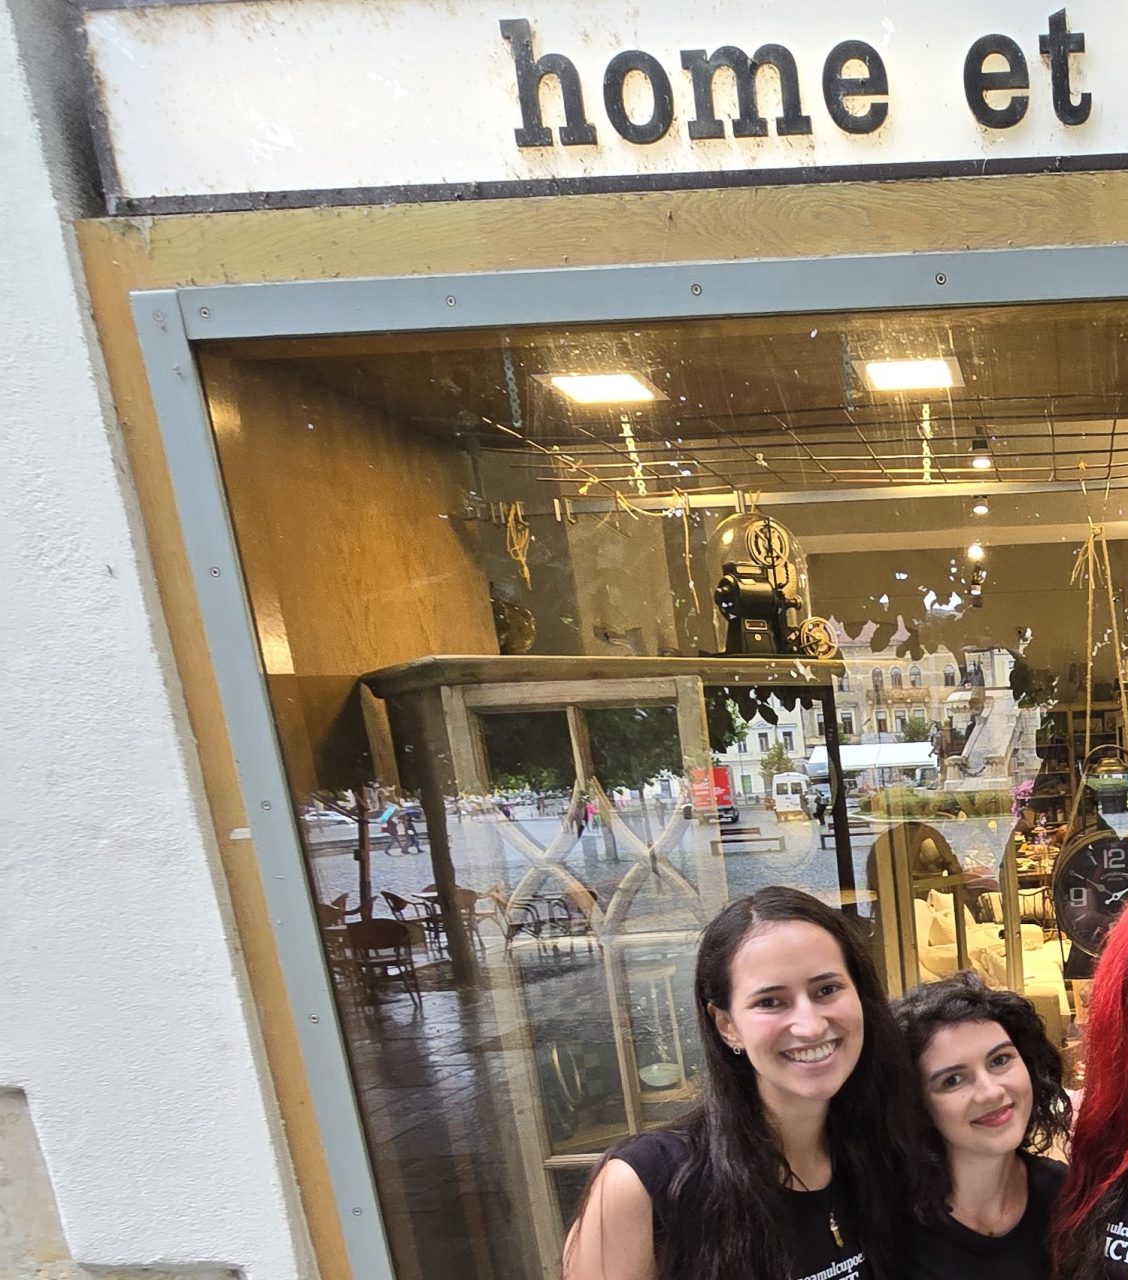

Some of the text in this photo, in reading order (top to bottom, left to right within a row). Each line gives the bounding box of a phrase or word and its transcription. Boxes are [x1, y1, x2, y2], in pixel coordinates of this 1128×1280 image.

[499, 17, 889, 149] home
[963, 8, 1093, 129] et
[1103, 848, 1126, 869] 12
[1069, 887, 1088, 908] 9
